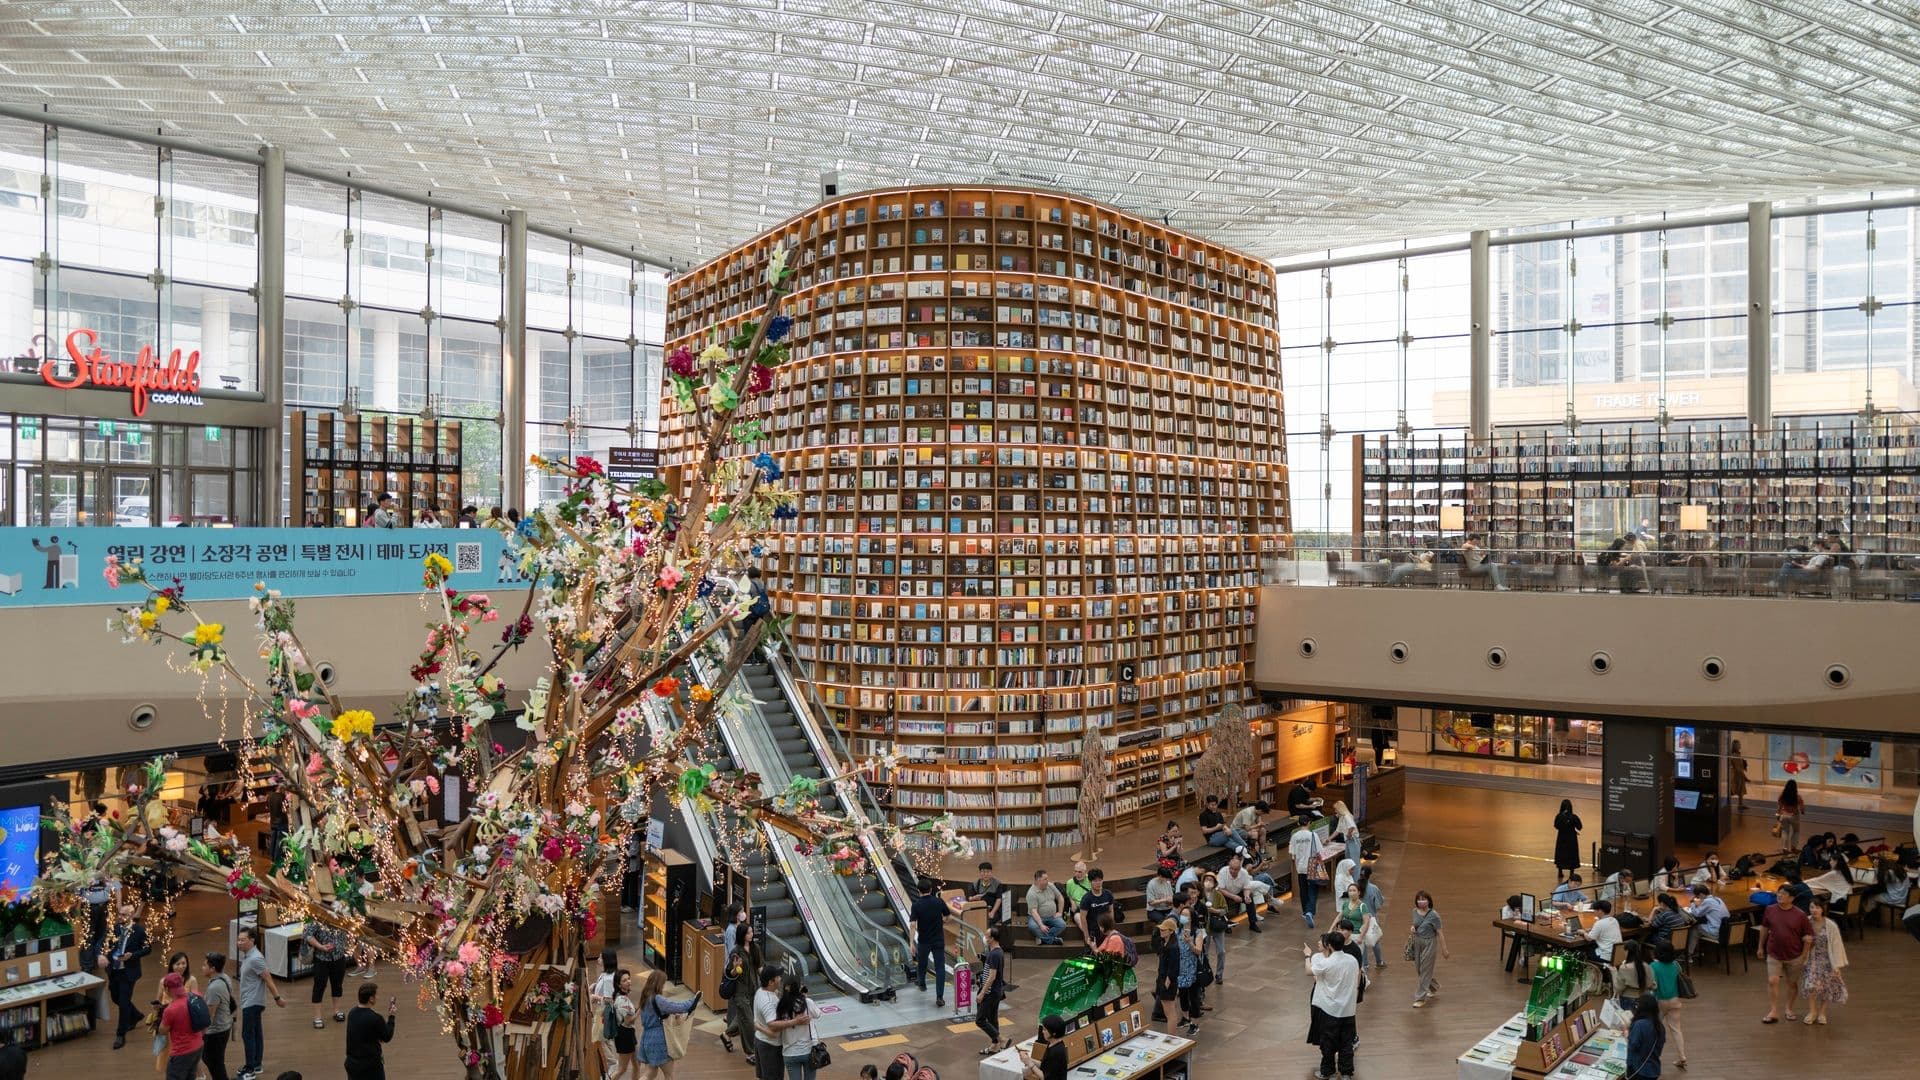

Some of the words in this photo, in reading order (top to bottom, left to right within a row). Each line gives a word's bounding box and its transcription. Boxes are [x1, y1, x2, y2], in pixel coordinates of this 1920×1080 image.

[41, 328, 201, 417] Starfield
[180, 395, 204, 406] MALL
[1594, 394, 1642, 409] TRADE
[107, 544, 144, 564] 열린
[150, 544, 186, 564] 강연
[201, 544, 252, 563] 소장각
[255, 544, 288, 562] 공연
[301, 543, 331, 562] 특별
[335, 543, 364, 561] 전시
[376, 543, 405, 560] 테마
[408, 543, 448, 560] 도서전
[329, 568, 356, 578] 있습니다
[1122, 666, 1132, 681] C
